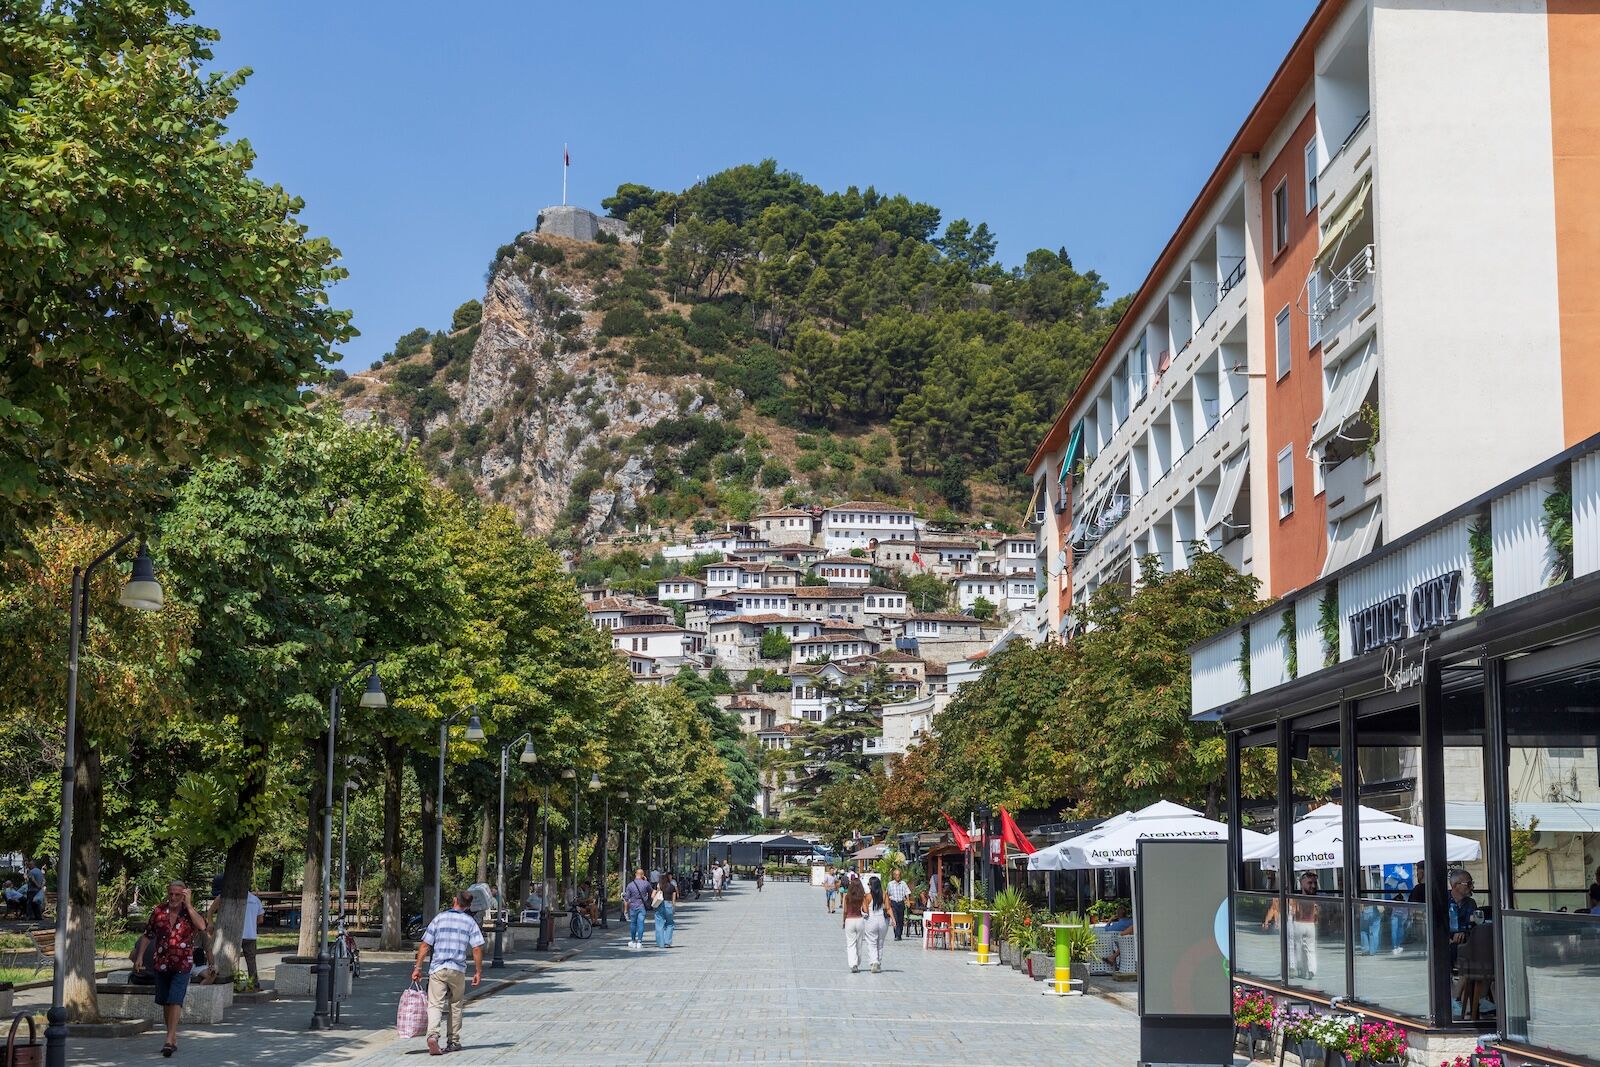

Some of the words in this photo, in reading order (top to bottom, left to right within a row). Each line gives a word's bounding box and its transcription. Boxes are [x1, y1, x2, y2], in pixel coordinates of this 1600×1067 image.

[1349, 593, 1408, 656] WHITE
[1410, 570, 1461, 633] CITY
[1139, 830, 1219, 839] Aranxhata
